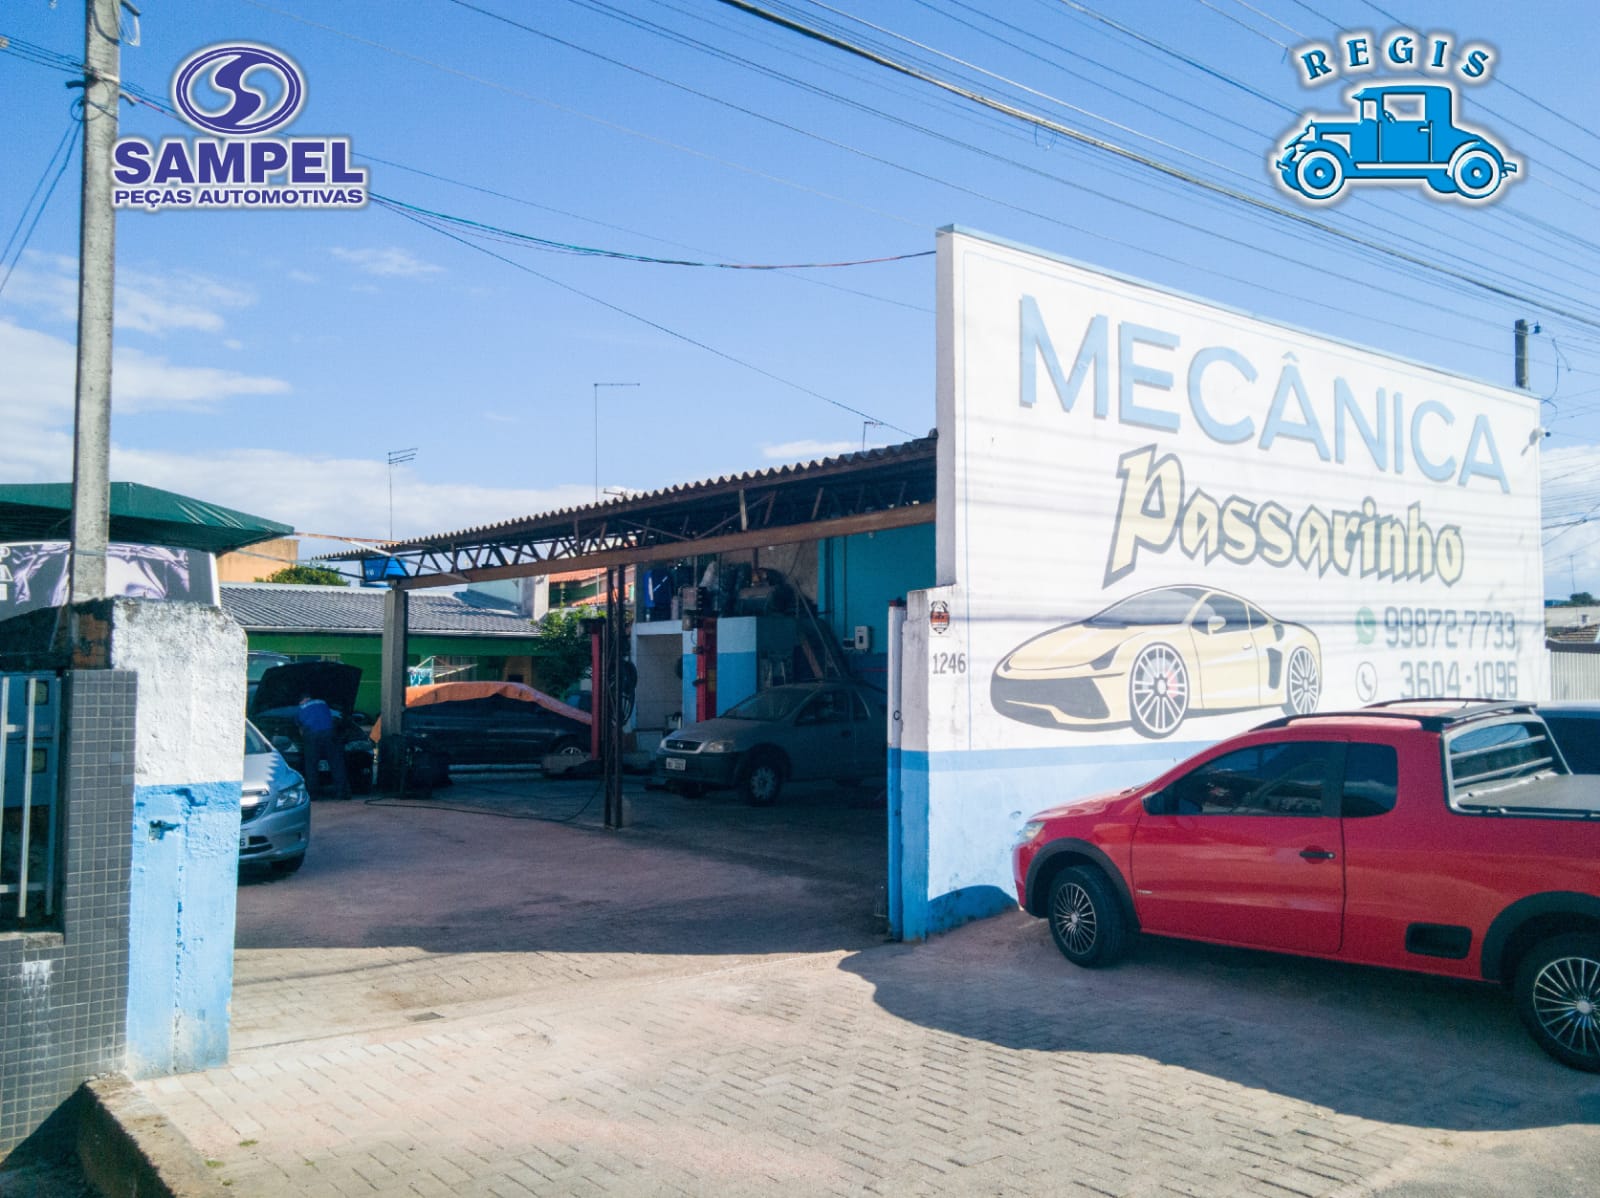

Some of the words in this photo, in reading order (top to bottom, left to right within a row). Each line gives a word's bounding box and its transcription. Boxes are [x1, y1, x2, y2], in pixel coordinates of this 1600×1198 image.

[1019, 294, 1511, 494] MECÂNICA
[1103, 443, 1464, 588] Passarinho
[932, 652, 967, 674] 1246
